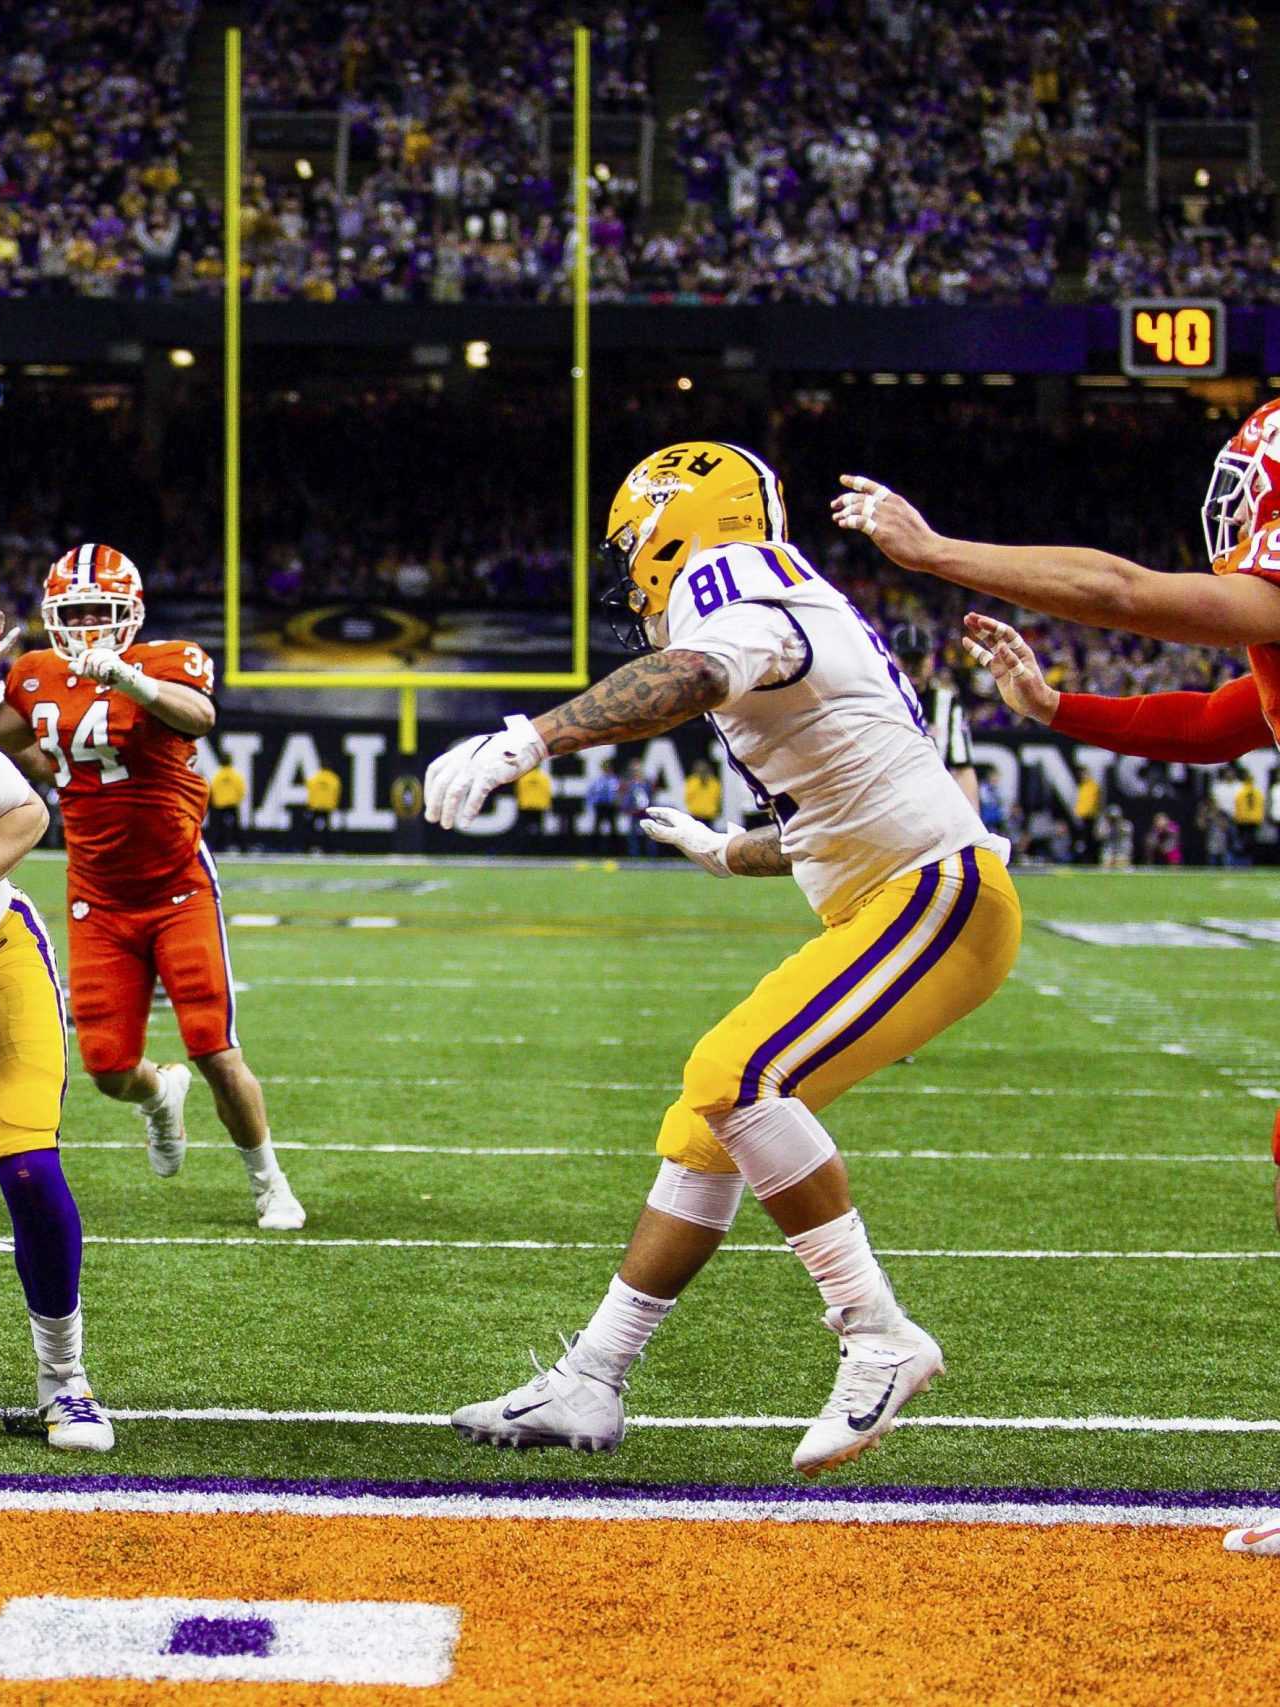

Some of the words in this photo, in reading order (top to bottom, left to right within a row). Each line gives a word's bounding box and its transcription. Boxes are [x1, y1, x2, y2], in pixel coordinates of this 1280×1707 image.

[1136, 309, 1211, 366] 40
[688, 556, 742, 618] 81
[32, 700, 130, 788] 34
